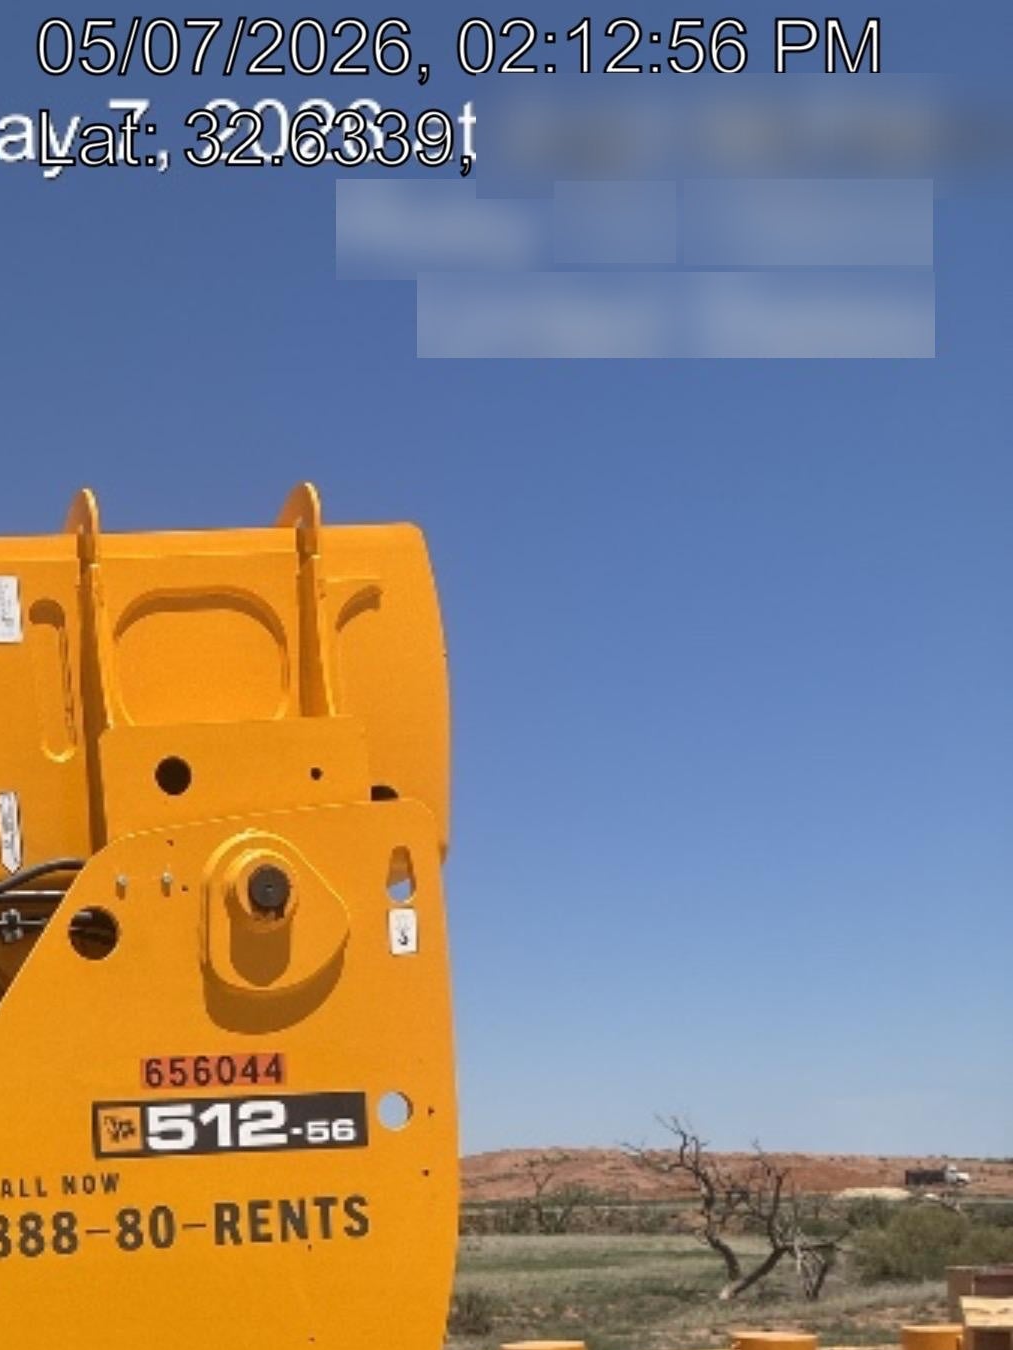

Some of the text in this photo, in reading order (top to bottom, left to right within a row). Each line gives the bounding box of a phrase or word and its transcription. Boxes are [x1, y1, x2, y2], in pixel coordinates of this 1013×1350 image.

[144, 1054, 284, 1087] 656044
[145, 1100, 356, 1151] 512-56
[62, 1172, 121, 1196] NOW
